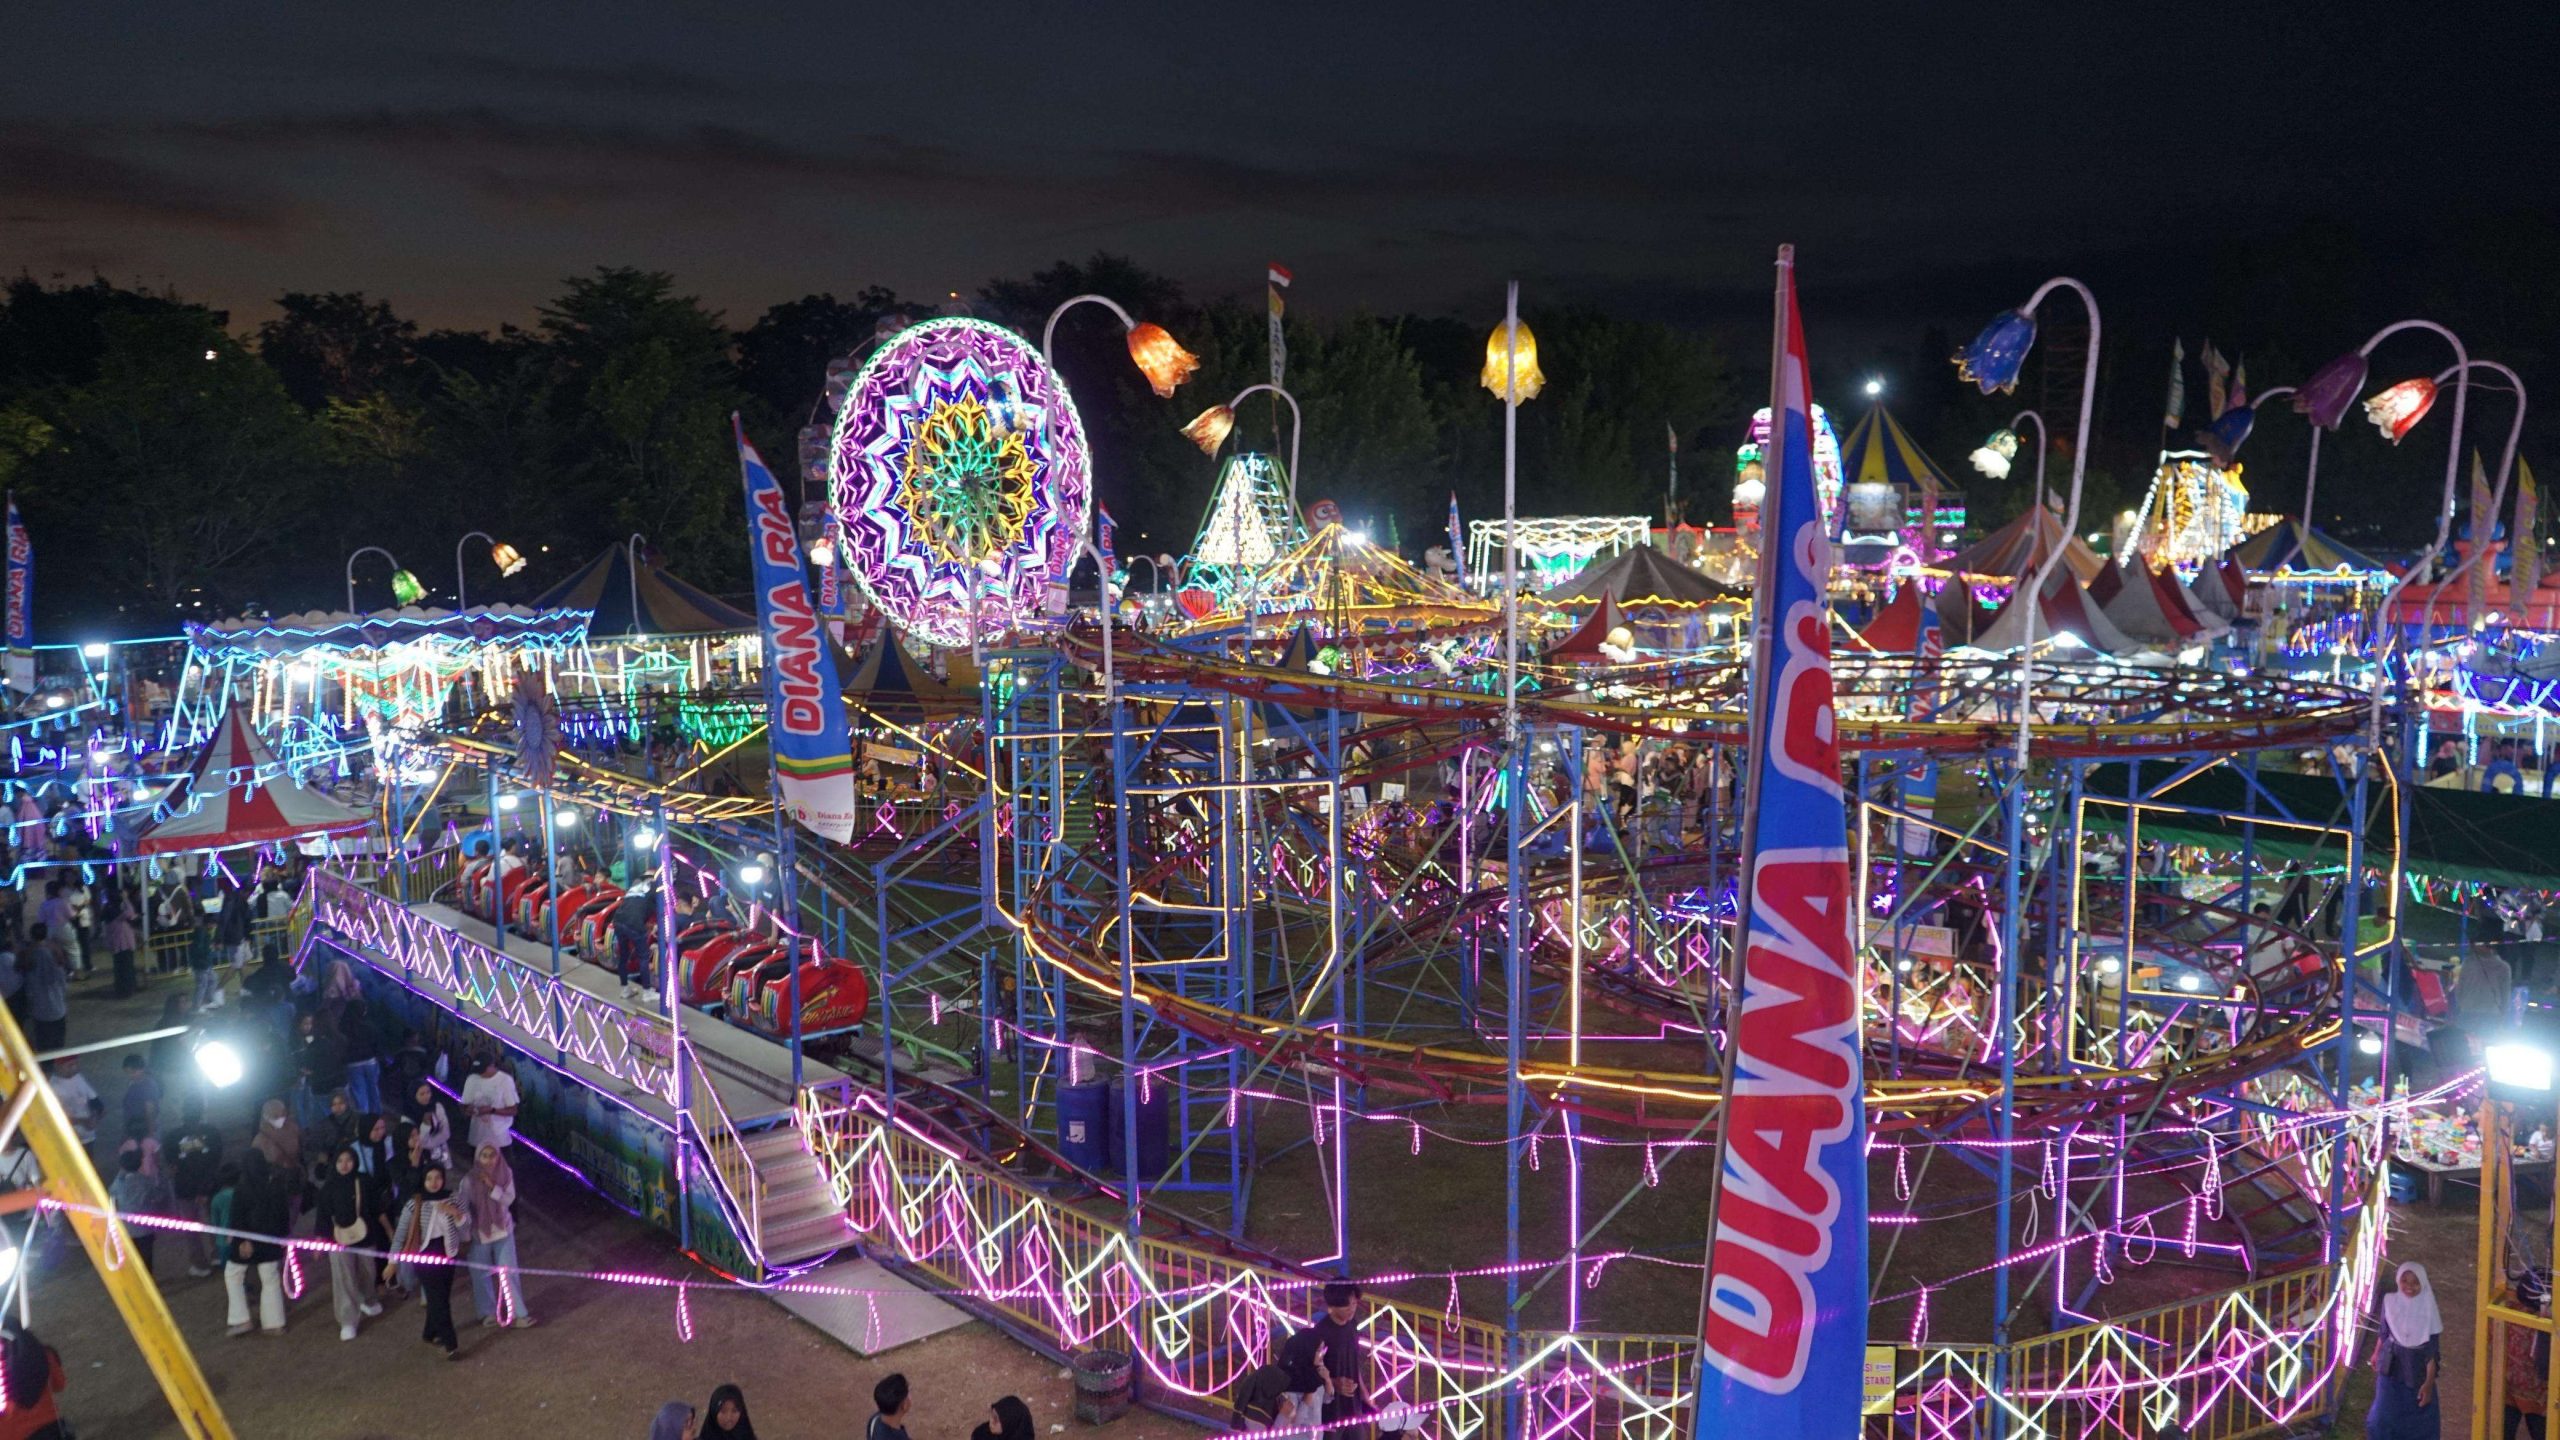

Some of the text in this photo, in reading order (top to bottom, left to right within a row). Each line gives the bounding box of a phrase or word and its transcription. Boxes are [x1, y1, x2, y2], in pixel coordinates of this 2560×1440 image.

[8, 525, 31, 639] DIANA RIA
[754, 488, 824, 735] DIANA RIA
[1703, 846, 1860, 1396] DIANA
[1864, 1376, 1891, 1385] STAND
